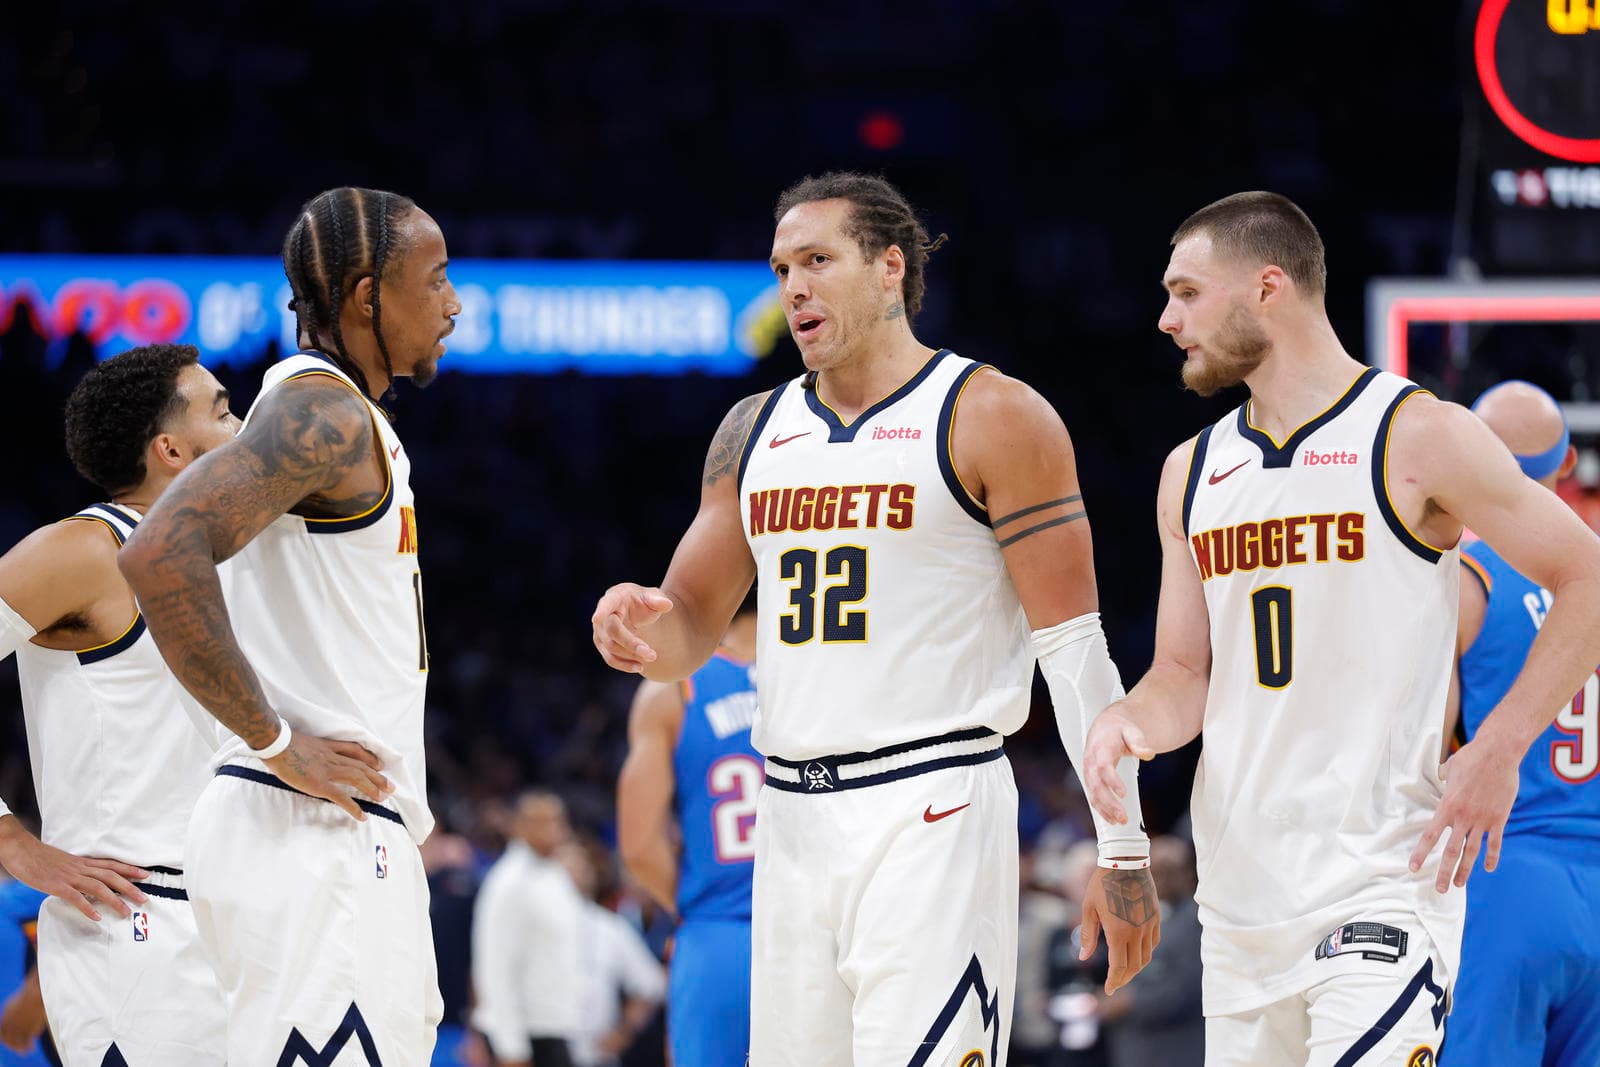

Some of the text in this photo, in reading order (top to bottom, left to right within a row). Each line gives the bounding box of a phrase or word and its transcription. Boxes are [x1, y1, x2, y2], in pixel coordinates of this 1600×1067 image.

[872, 426, 922, 441] ibotta
[1303, 451, 1358, 466] ibotta
[749, 482, 917, 539] NUGGETS
[1191, 511, 1366, 584] NUGGETS
[413, 570, 429, 673] 1
[778, 543, 869, 647] 32
[1250, 584, 1294, 692] 0
